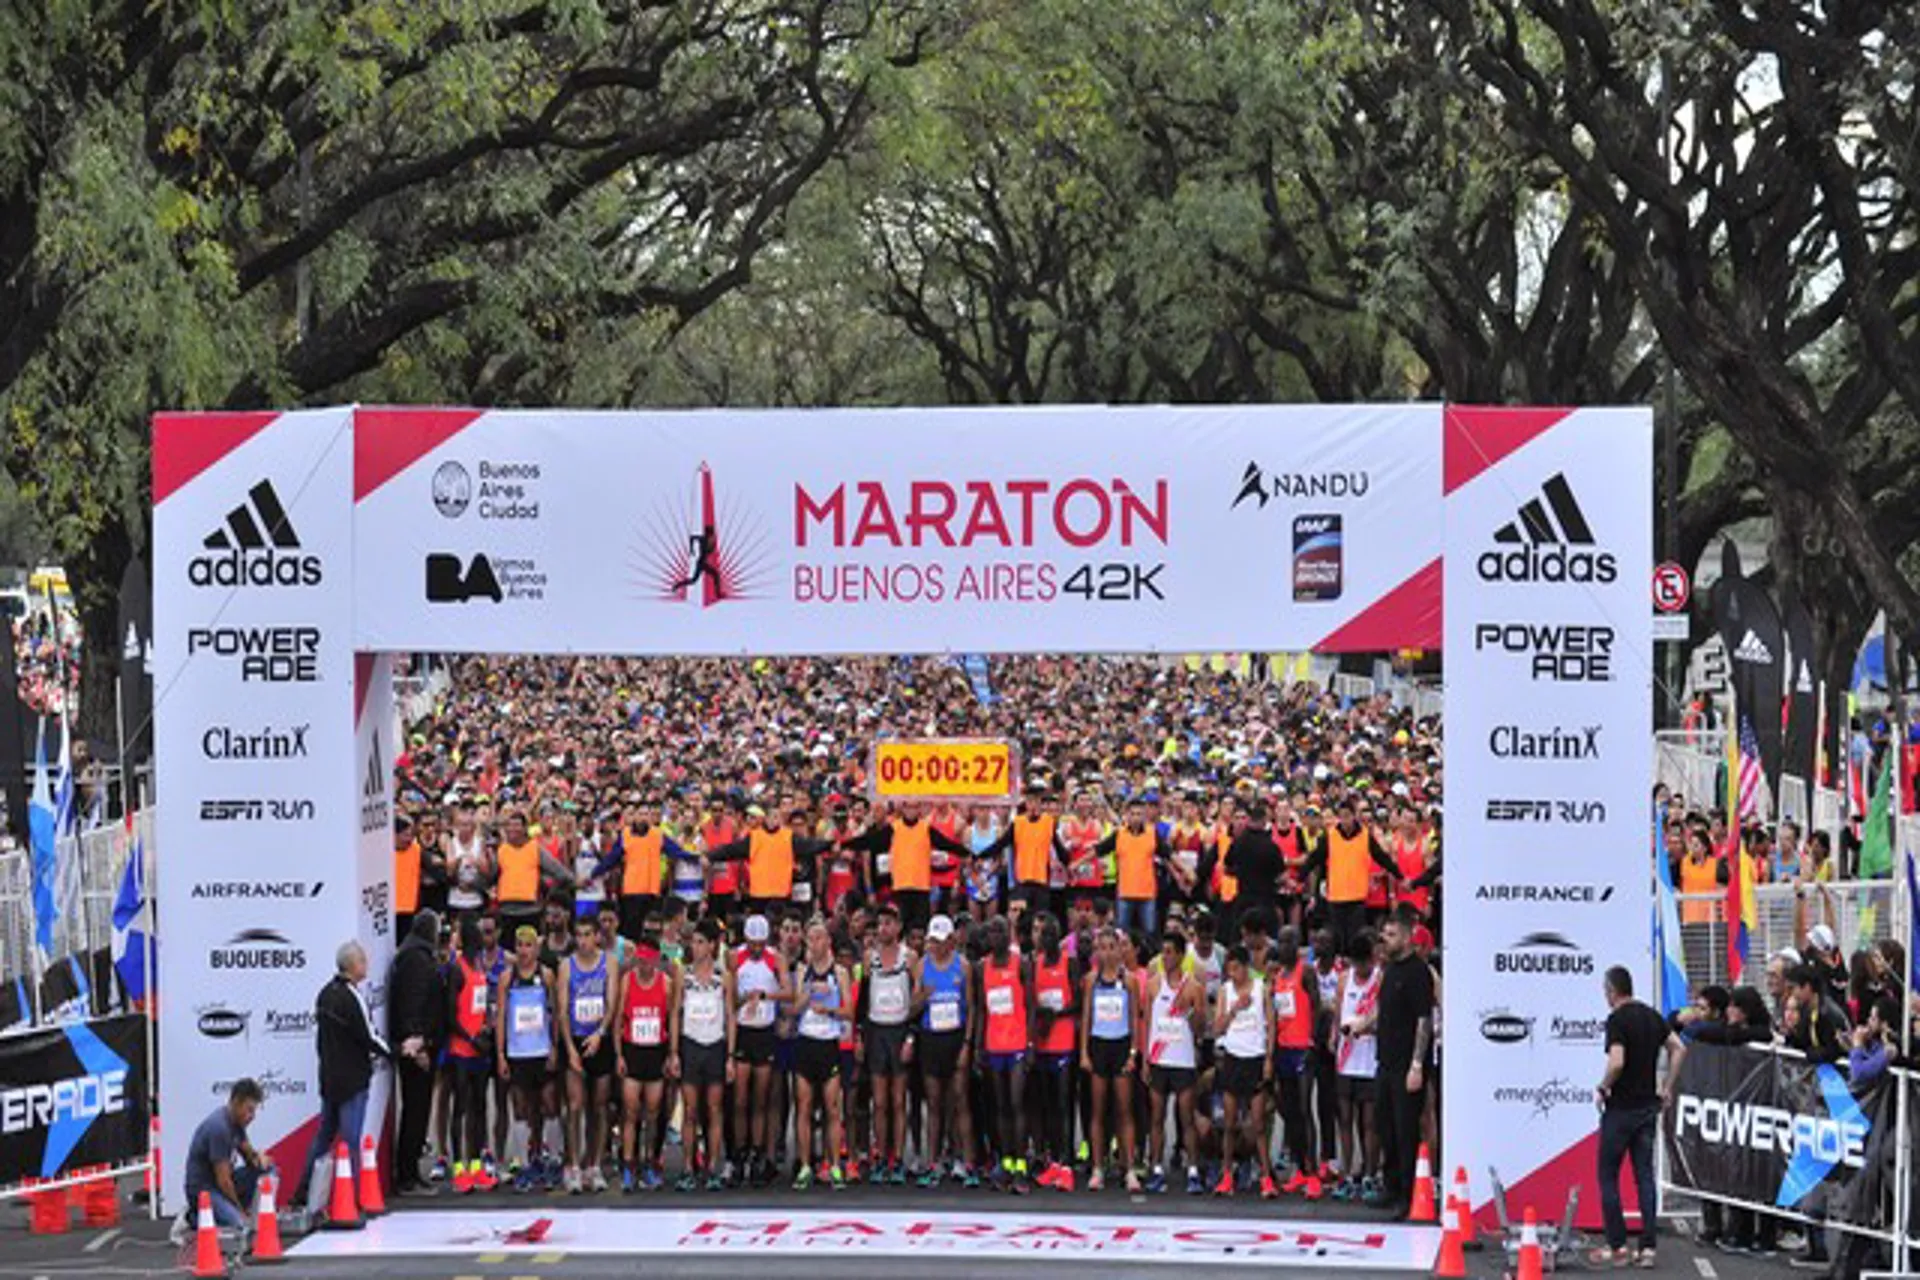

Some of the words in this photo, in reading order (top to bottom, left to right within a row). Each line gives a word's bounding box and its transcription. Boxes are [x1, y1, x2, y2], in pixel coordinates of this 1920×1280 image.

[479, 461, 540, 479] Buenos
[479, 482, 524, 499] Aires
[479, 501, 538, 519] Ciudad
[188, 548, 322, 586] adidas
[1477, 543, 1617, 583] adidas
[426, 552, 503, 603] BA
[795, 563, 945, 602] BUENOS
[954, 563, 1057, 602] AIRES
[1062, 563, 1165, 600] 42K
[188, 628, 321, 656] POWER
[1476, 623, 1615, 653] POWER
[242, 656, 318, 682] ADE
[1532, 654, 1611, 681] ADE
[203, 726, 290, 759] Clarín
[1490, 725, 1583, 759] Clarín
[881, 755, 1005, 783] 00:00:27
[200, 801, 262, 820] ESPN
[267, 800, 315, 820] RUN
[1486, 800, 1551, 821] ESPN
[1555, 800, 1606, 823] RUN
[210, 950, 307, 970] BUQUEBUS
[1494, 953, 1595, 975] BUQUEBUS
[1675, 1094, 1868, 1168] POWERADE
